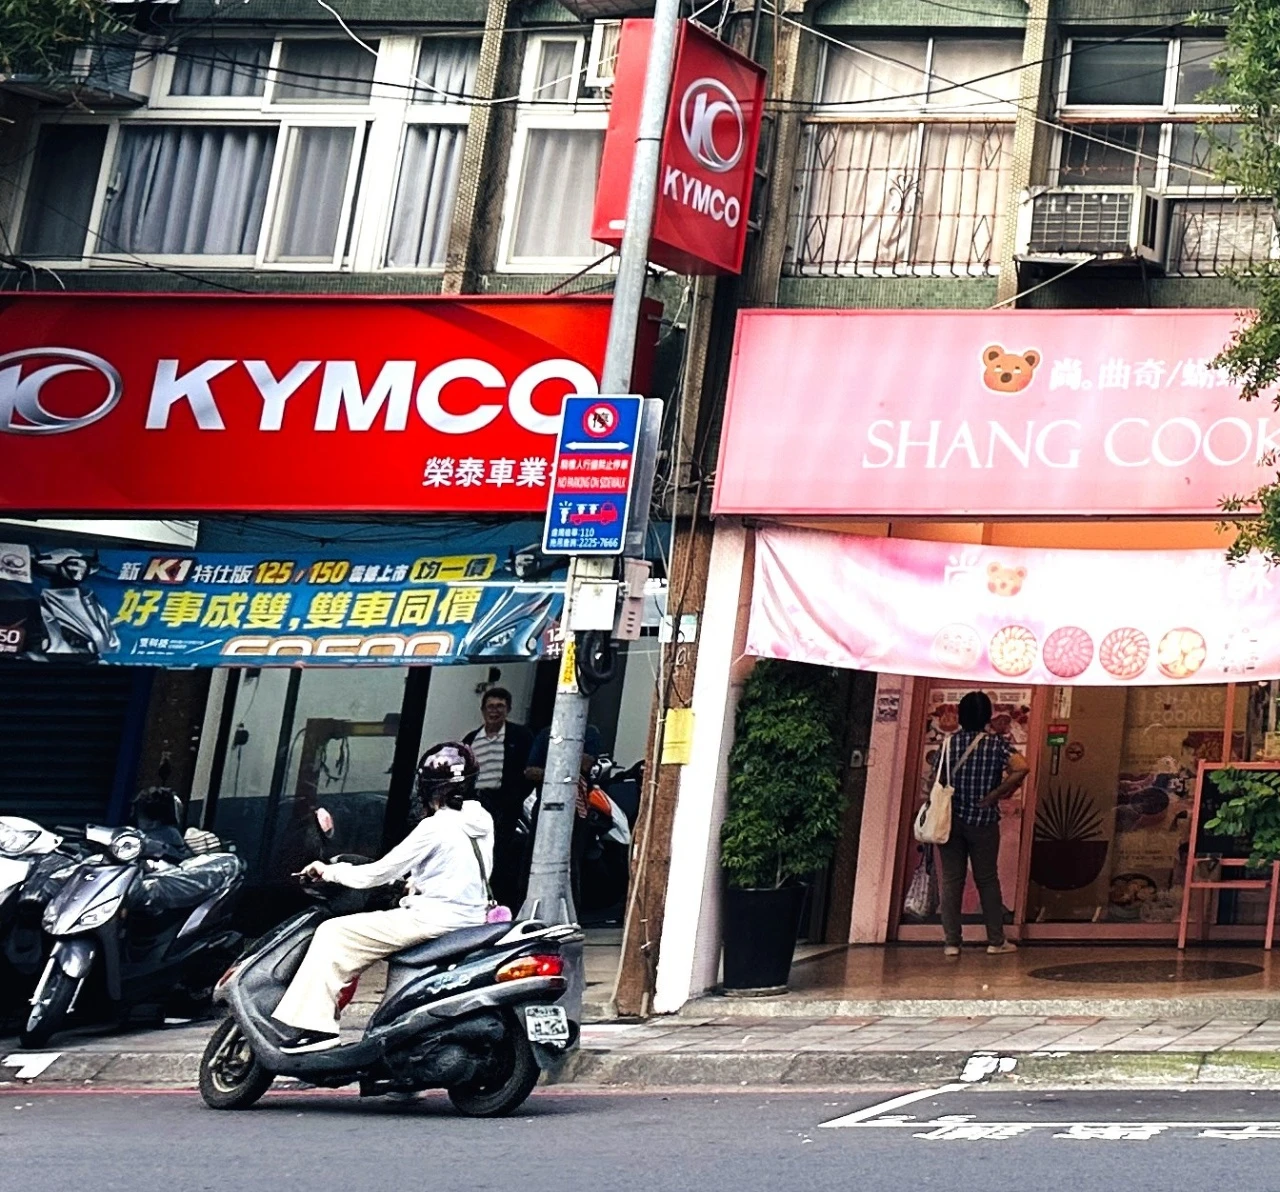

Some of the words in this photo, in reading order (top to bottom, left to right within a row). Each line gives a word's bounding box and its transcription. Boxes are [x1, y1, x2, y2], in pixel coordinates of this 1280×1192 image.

[663, 164, 740, 228] KYMCO
[145, 357, 600, 435] KYMCO
[861, 419, 1081, 470] SHANG
[422, 455, 562, 488] 榮泰車業
[118, 562, 142, 581] 新
[144, 558, 193, 582] K1
[191, 564, 254, 584] 特仕版
[255, 561, 294, 584] 125
[308, 560, 349, 584] 150
